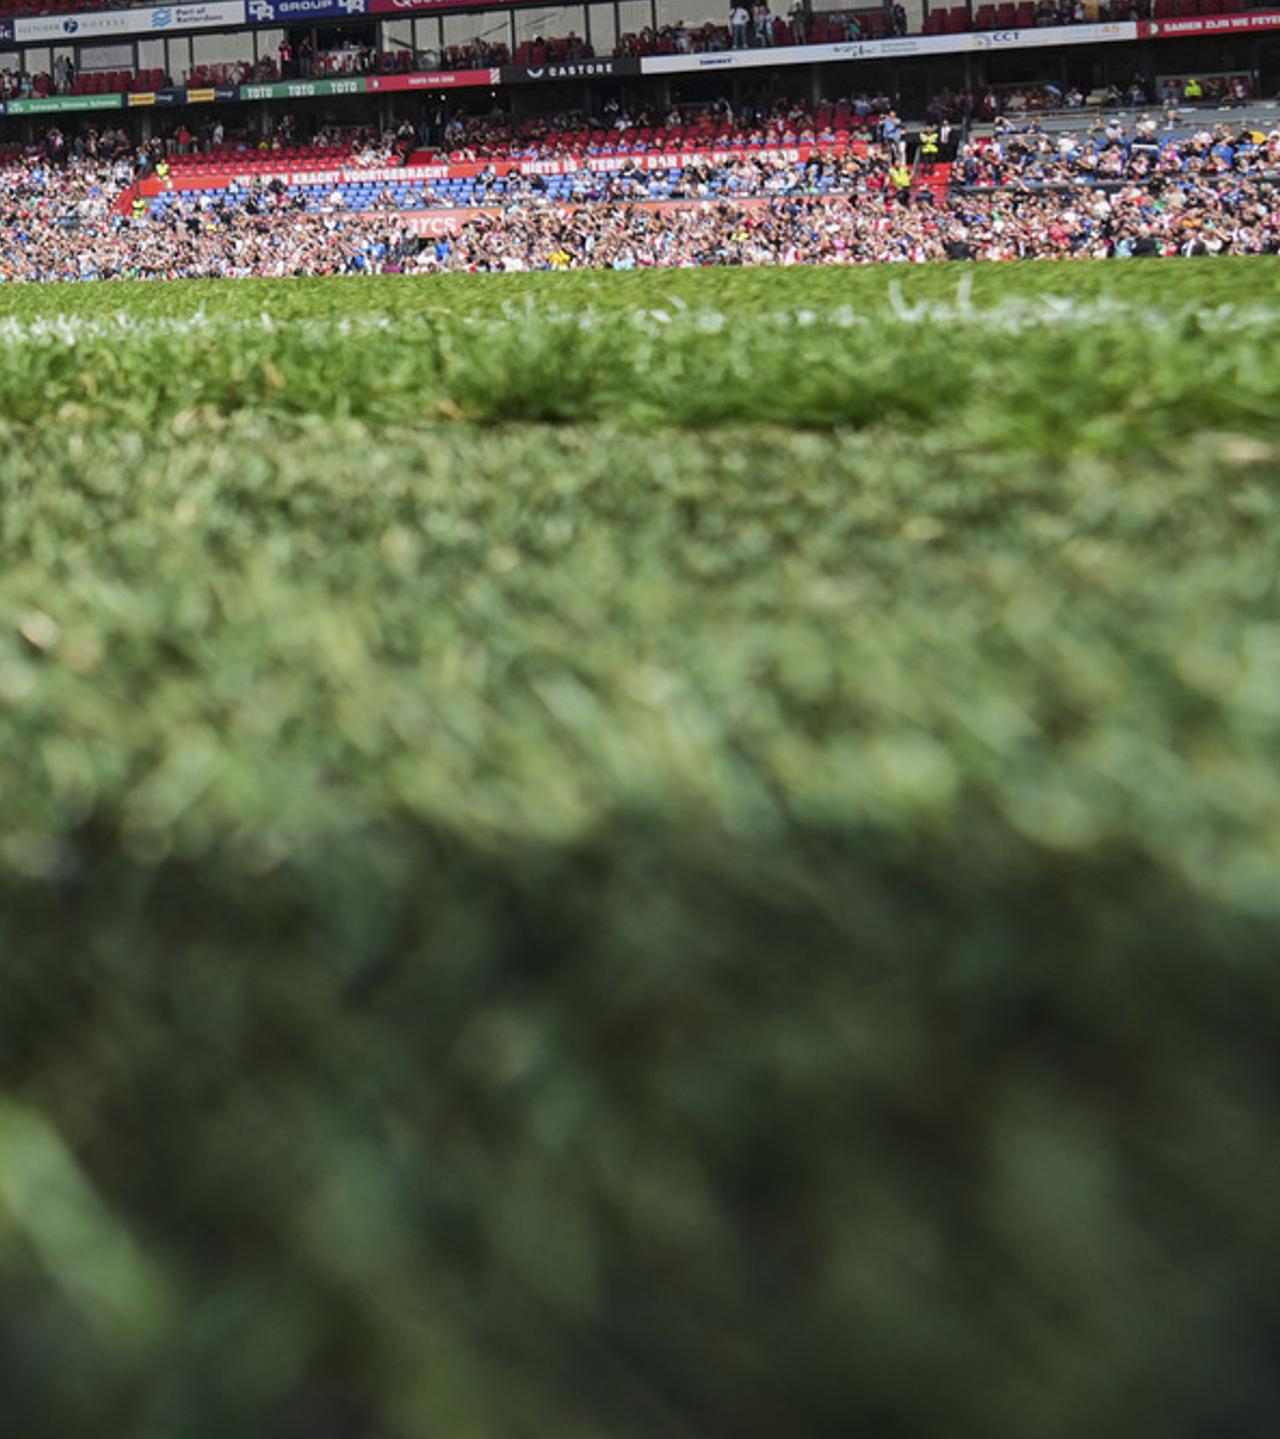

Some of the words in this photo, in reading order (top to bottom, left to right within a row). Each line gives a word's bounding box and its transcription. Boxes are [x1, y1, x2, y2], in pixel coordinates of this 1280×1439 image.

[278, 0, 333, 12] GROUP
[548, 63, 613, 76] CASTORE
[247, 87, 273, 98] TOTO
[288, 84, 314, 96] TOTO
[330, 82, 358, 93] TOTO
